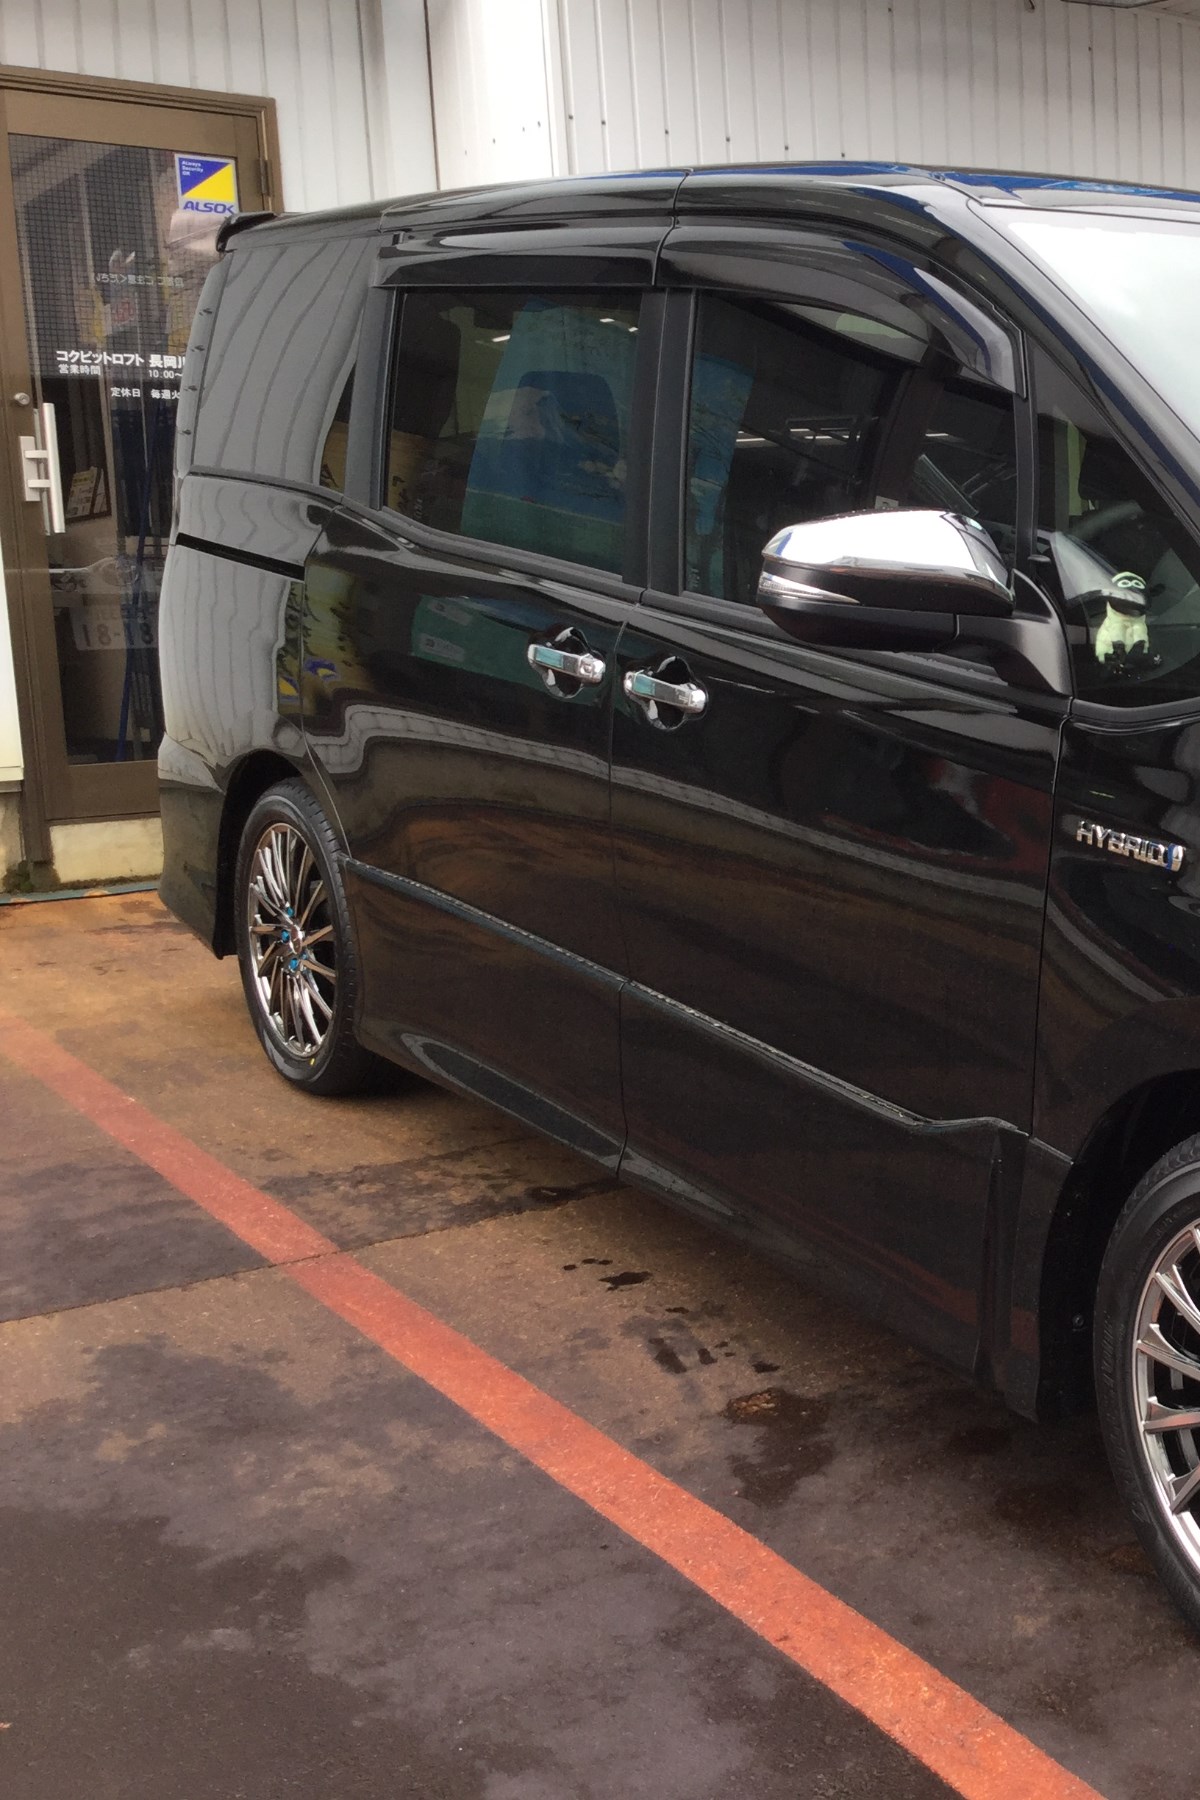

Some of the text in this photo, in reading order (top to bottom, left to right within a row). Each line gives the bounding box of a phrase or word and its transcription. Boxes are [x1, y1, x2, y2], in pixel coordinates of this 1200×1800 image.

[183, 200, 235, 215] ALSOK
[58, 363, 101, 375] 営業時間
[110, 386, 141, 398] 定休日
[1076, 820, 1168, 867] HYBRID
